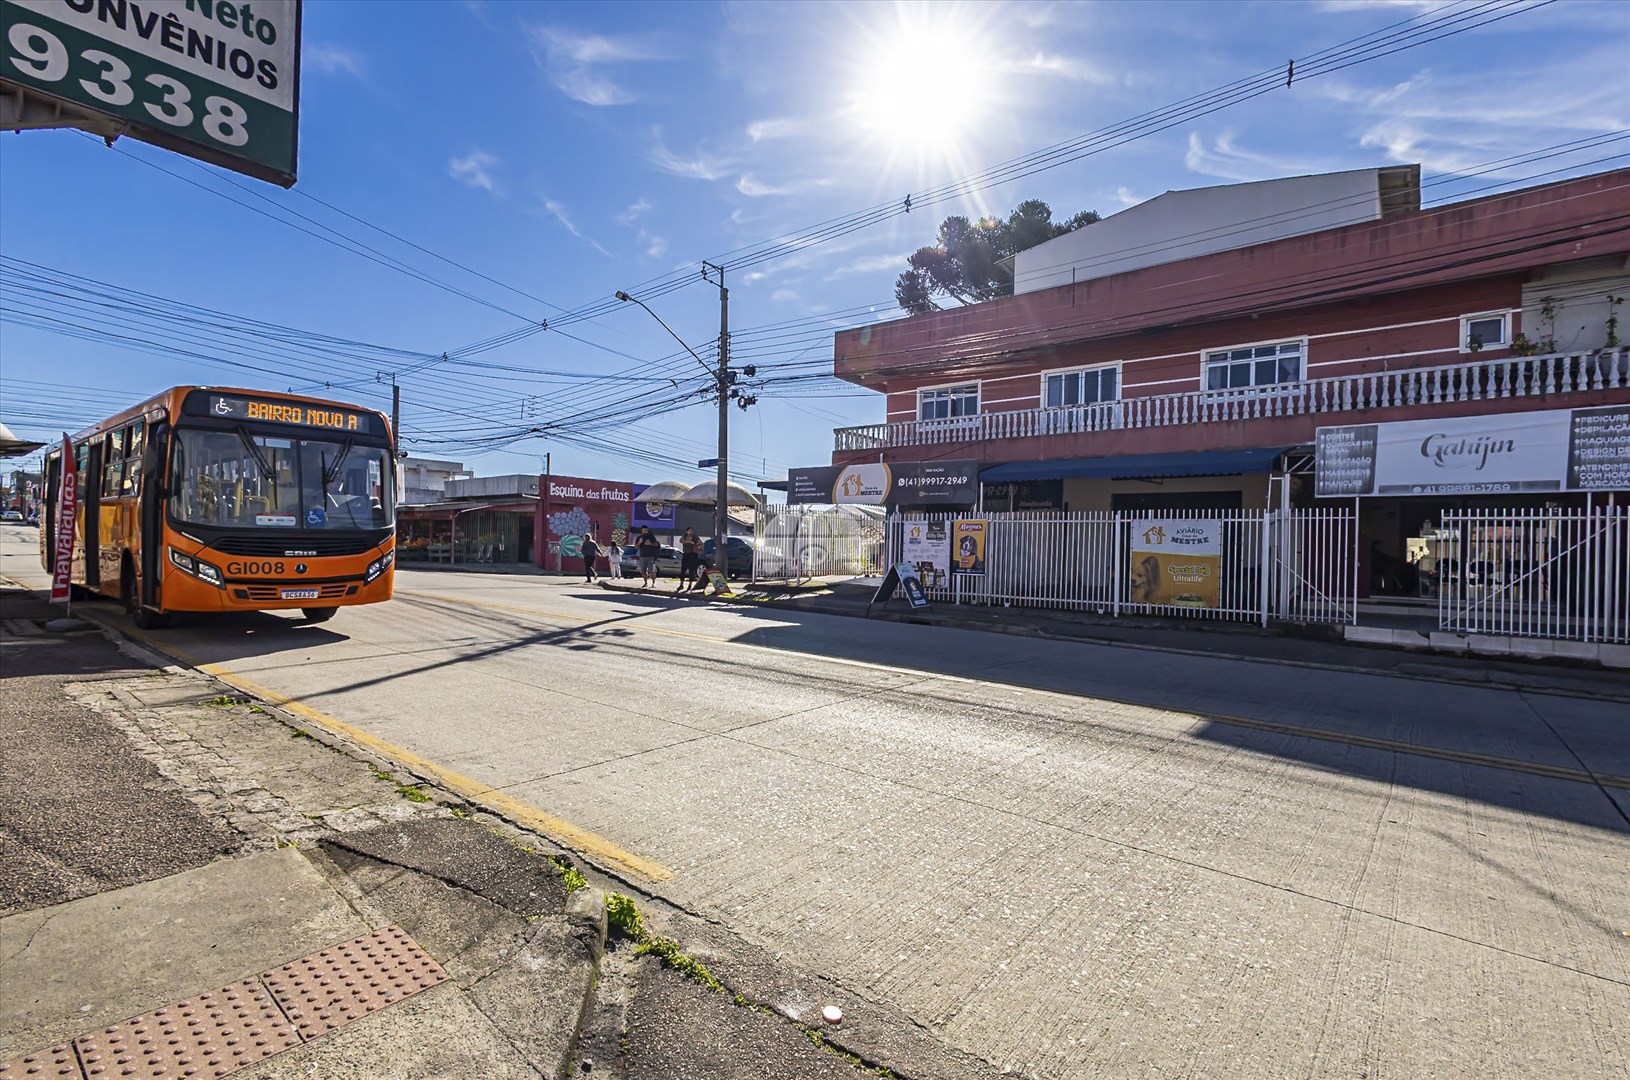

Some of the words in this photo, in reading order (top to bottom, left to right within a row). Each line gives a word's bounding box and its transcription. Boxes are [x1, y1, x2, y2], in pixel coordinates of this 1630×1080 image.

[8, 23, 249, 147] 9338
[248, 401, 302, 424] BAIRRO
[307, 409, 344, 429] NOVO
[348, 415, 357, 431] A
[1580, 414, 1629, 423] PEDICURE
[1326, 433, 1355, 441] CORTES
[1361, 440, 1373, 449] EM
[1580, 447, 1617, 455] DESIGN
[1580, 472, 1602, 481] COM
[1604, 471, 1630, 480] HORA
[1325, 480, 1363, 488] MANICURE
[1580, 480, 1630, 488] MARCADA
[549, 482, 585, 500] Esquina
[586, 488, 600, 500] das
[600, 487, 630, 502] frutas
[53, 472, 76, 590] havaianas
[1176, 527, 1204, 535] AVIÁRIO
[1170, 536, 1210, 545] MESTRE
[227, 561, 285, 575] GI008
[1173, 575, 1203, 583] Ultralife
